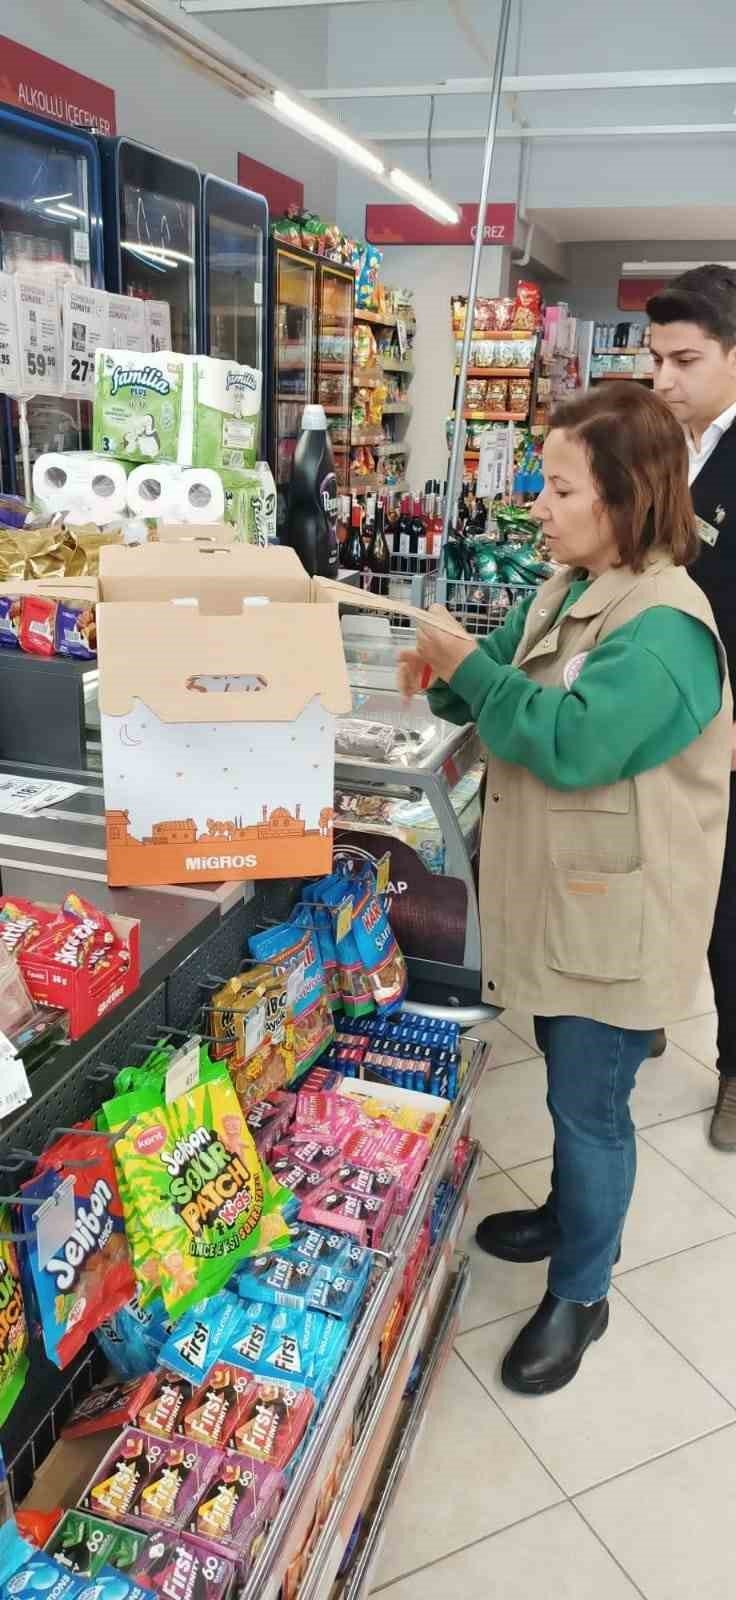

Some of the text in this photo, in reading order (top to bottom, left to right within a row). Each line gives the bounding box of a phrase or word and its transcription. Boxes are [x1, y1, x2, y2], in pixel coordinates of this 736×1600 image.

[18, 82, 63, 118] ALKOLLÜ
[470, 225, 505, 241] ÇREZ
[71, 358, 89, 382] 27
[110, 366, 170, 396] familia
[102, 437, 110, 452] 3
[160, 1126, 211, 1176] Jelibon
[295, 1140, 322, 1163] First
[169, 1141, 231, 1205] SOUR
[278, 1165, 306, 1190] First
[351, 1168, 371, 1193] First
[180, 1157, 250, 1231] PATCH
[218, 1188, 252, 1226] Kids
[46, 1178, 113, 1291] Jelibon
[297, 1229, 321, 1256] First
[267, 1257, 290, 1288] First
[180, 1321, 209, 1366] First
[239, 1322, 267, 1362] First
[275, 1334, 297, 1373] First
[233, 1376, 247, 1393] 60
[150, 1385, 180, 1429] First
[191, 1390, 223, 1435] First
[243, 1403, 275, 1450] First
[146, 1445, 162, 1464] 60
[182, 1452, 196, 1469] 60
[100, 1461, 135, 1512] First
[149, 1468, 179, 1517] First
[239, 1470, 252, 1487] 60
[203, 1484, 236, 1528] First
[86, 1530, 103, 1552] 60
[162, 1545, 193, 1600] First
[201, 1556, 218, 1581] 60
